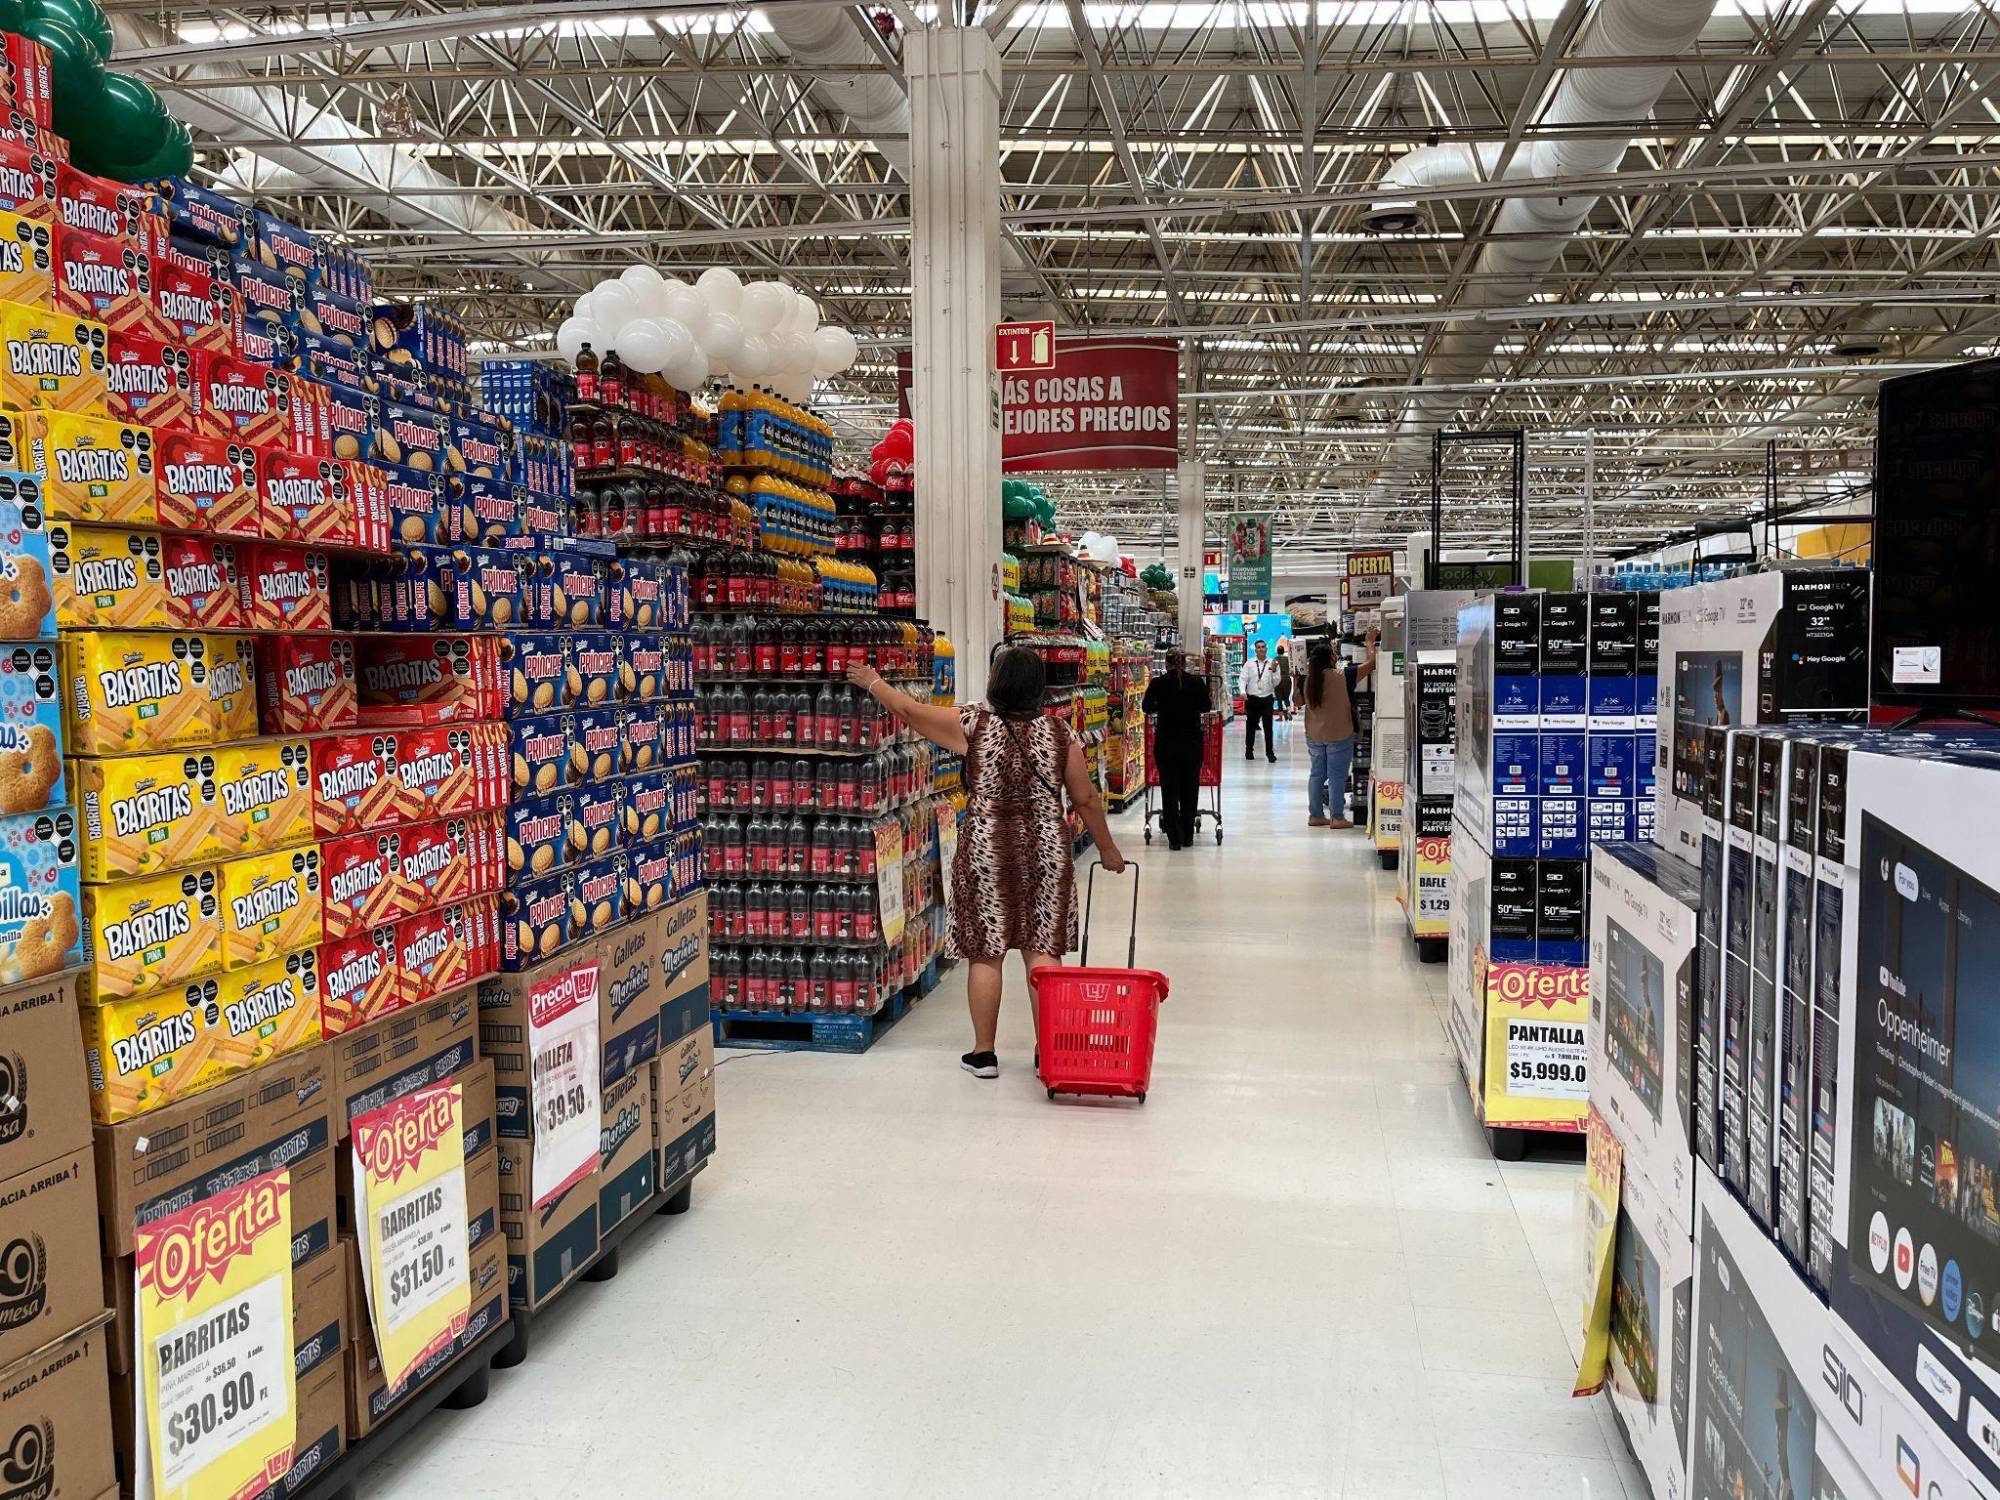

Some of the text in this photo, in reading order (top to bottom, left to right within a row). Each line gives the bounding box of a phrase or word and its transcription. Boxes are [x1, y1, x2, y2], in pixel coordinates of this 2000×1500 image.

[998, 328, 1030, 336] EXTINTOR
[1001, 376, 1124, 405] ÁS COSAS A
[1001, 406, 1171, 436] EJORES PRECIOS
[75, 560, 138, 595] ARRITAS
[1349, 556, 1392, 575] OFERTA
[1809, 603, 1834, 612] Google
[1811, 617, 1830, 625] 32"
[1821, 655, 1845, 663] Google
[1420, 878, 1447, 888] BAFLE
[666, 906, 697, 938] Galletas
[614, 933, 646, 966] Galletas
[662, 931, 699, 973] Marinela
[532, 978, 572, 1017] Precio
[611, 969, 649, 1007] Marinela
[1509, 1025, 1584, 1045] PANTALLA
[1878, 998, 1950, 1067] Oppenheimer
[376, 1094, 449, 1173] Oferta
[601, 1102, 640, 1151] Marinela
[0, 1170, 70, 1208] ACIA ARRIBA
[381, 1187, 442, 1242] BARRITAS
[158, 1191, 278, 1290] Oferta
[390, 1244, 444, 1306] $31.50
[159, 1302, 249, 1377] BARRITAS
[2, 1351, 81, 1401] HACIA ARRIBA
[168, 1370, 254, 1457] $30.90
